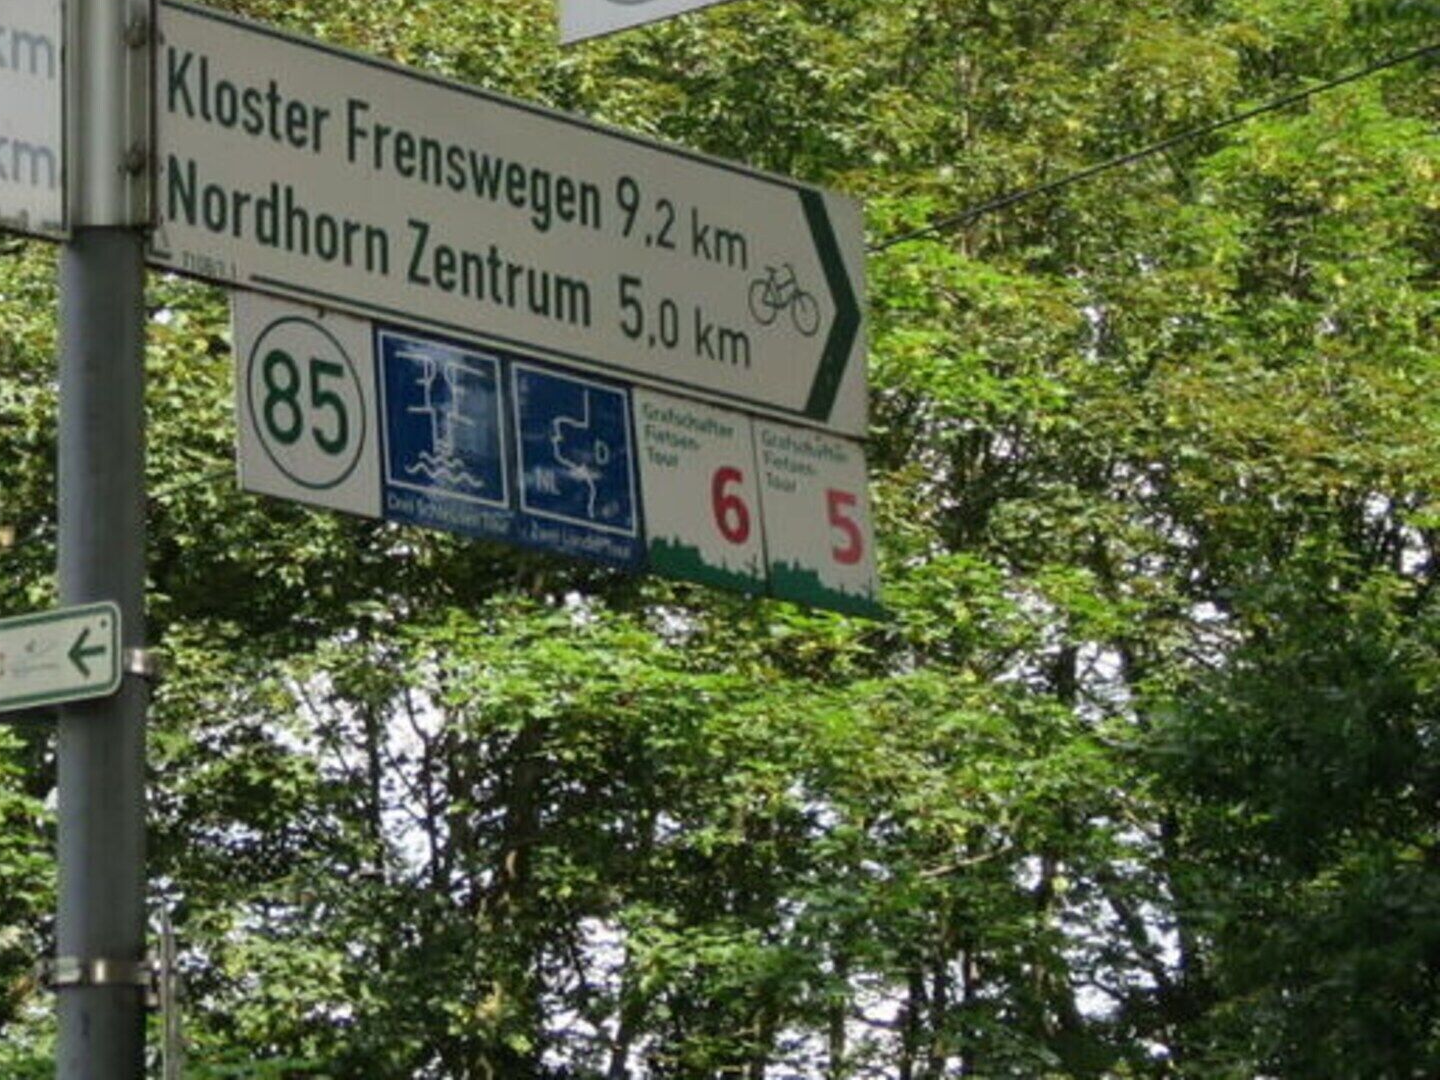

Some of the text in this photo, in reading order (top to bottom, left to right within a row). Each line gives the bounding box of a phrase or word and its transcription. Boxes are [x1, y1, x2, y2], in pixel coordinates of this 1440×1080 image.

[167, 46, 748, 270] Kloster Frenswegen 9,2 km
[167, 155, 751, 368] Nordhorn Zentrum 5,0 km
[263, 349, 349, 455] 85
[594, 439, 610, 465] D
[712, 466, 750, 545] 6
[826, 488, 863, 565] 5
